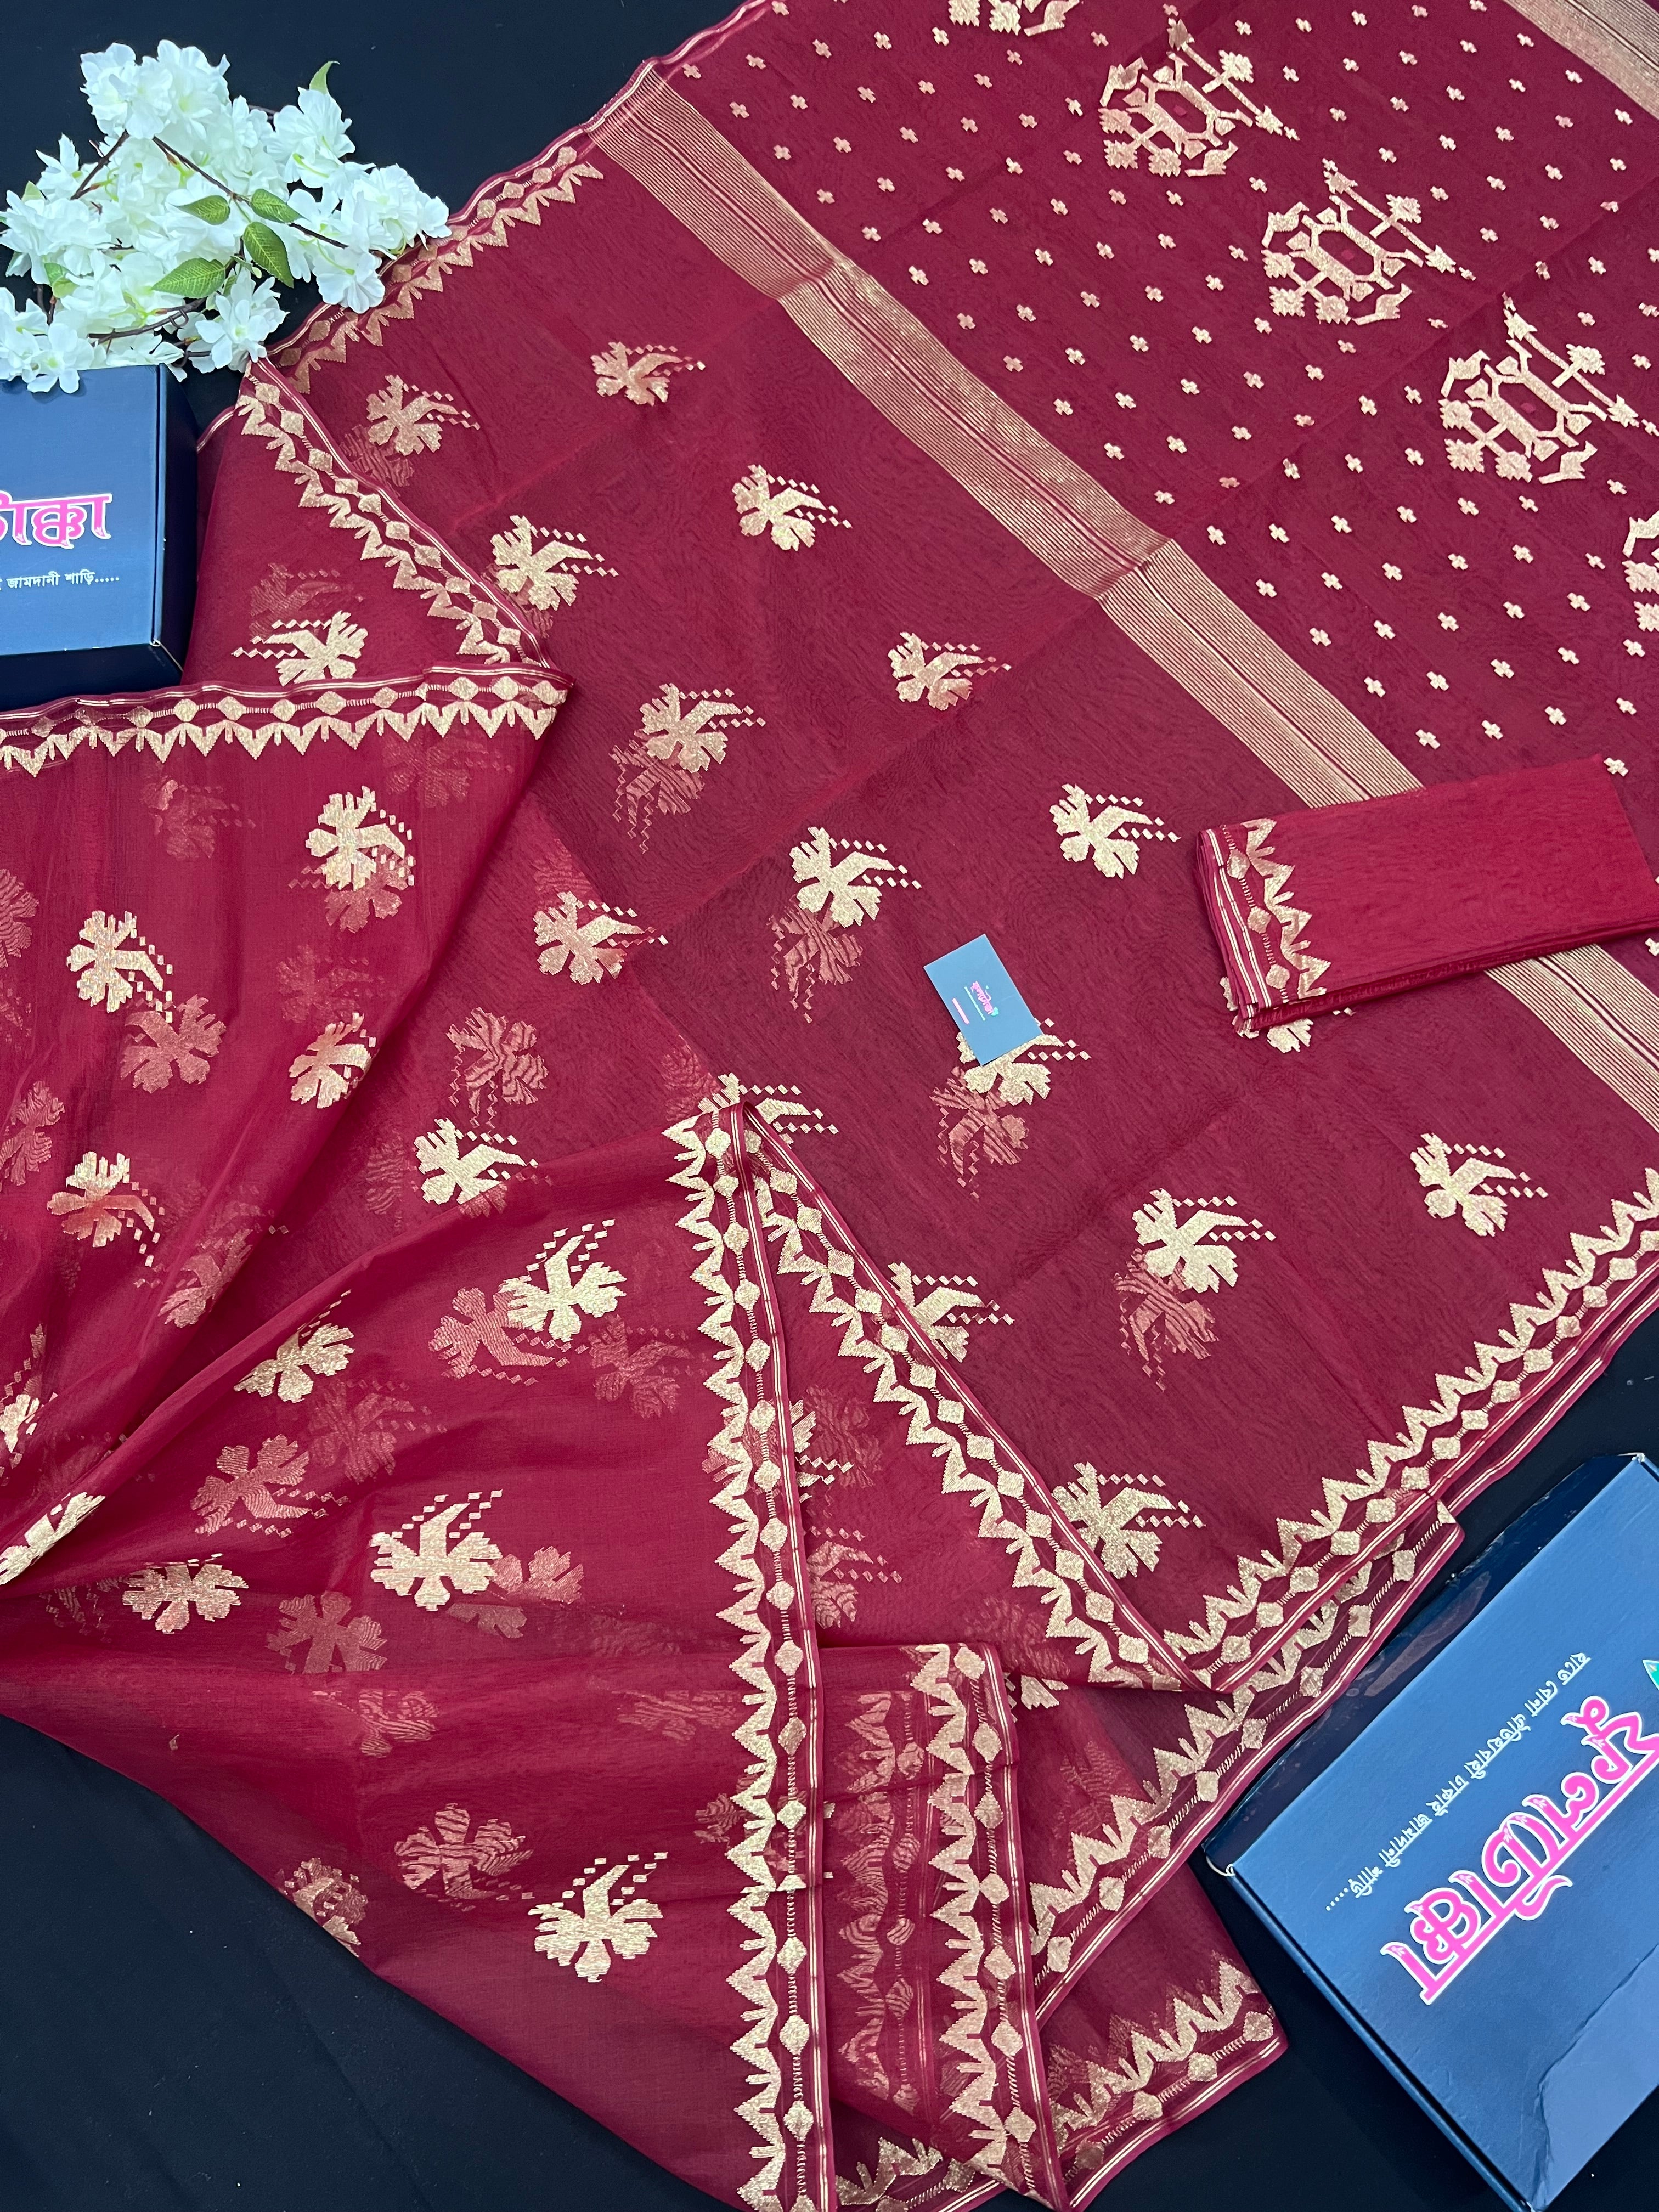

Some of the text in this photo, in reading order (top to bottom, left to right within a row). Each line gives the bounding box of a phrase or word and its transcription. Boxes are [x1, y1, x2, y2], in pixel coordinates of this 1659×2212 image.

[6, 571, 60, 589] জামদানী
[1557, 1652, 1591, 1685] হাতে
[1524, 1681, 1558, 1717] বোনা
[1426, 1775, 1469, 1816] ঢাকাই
[1378, 1814, 1433, 1867] জামদানী
